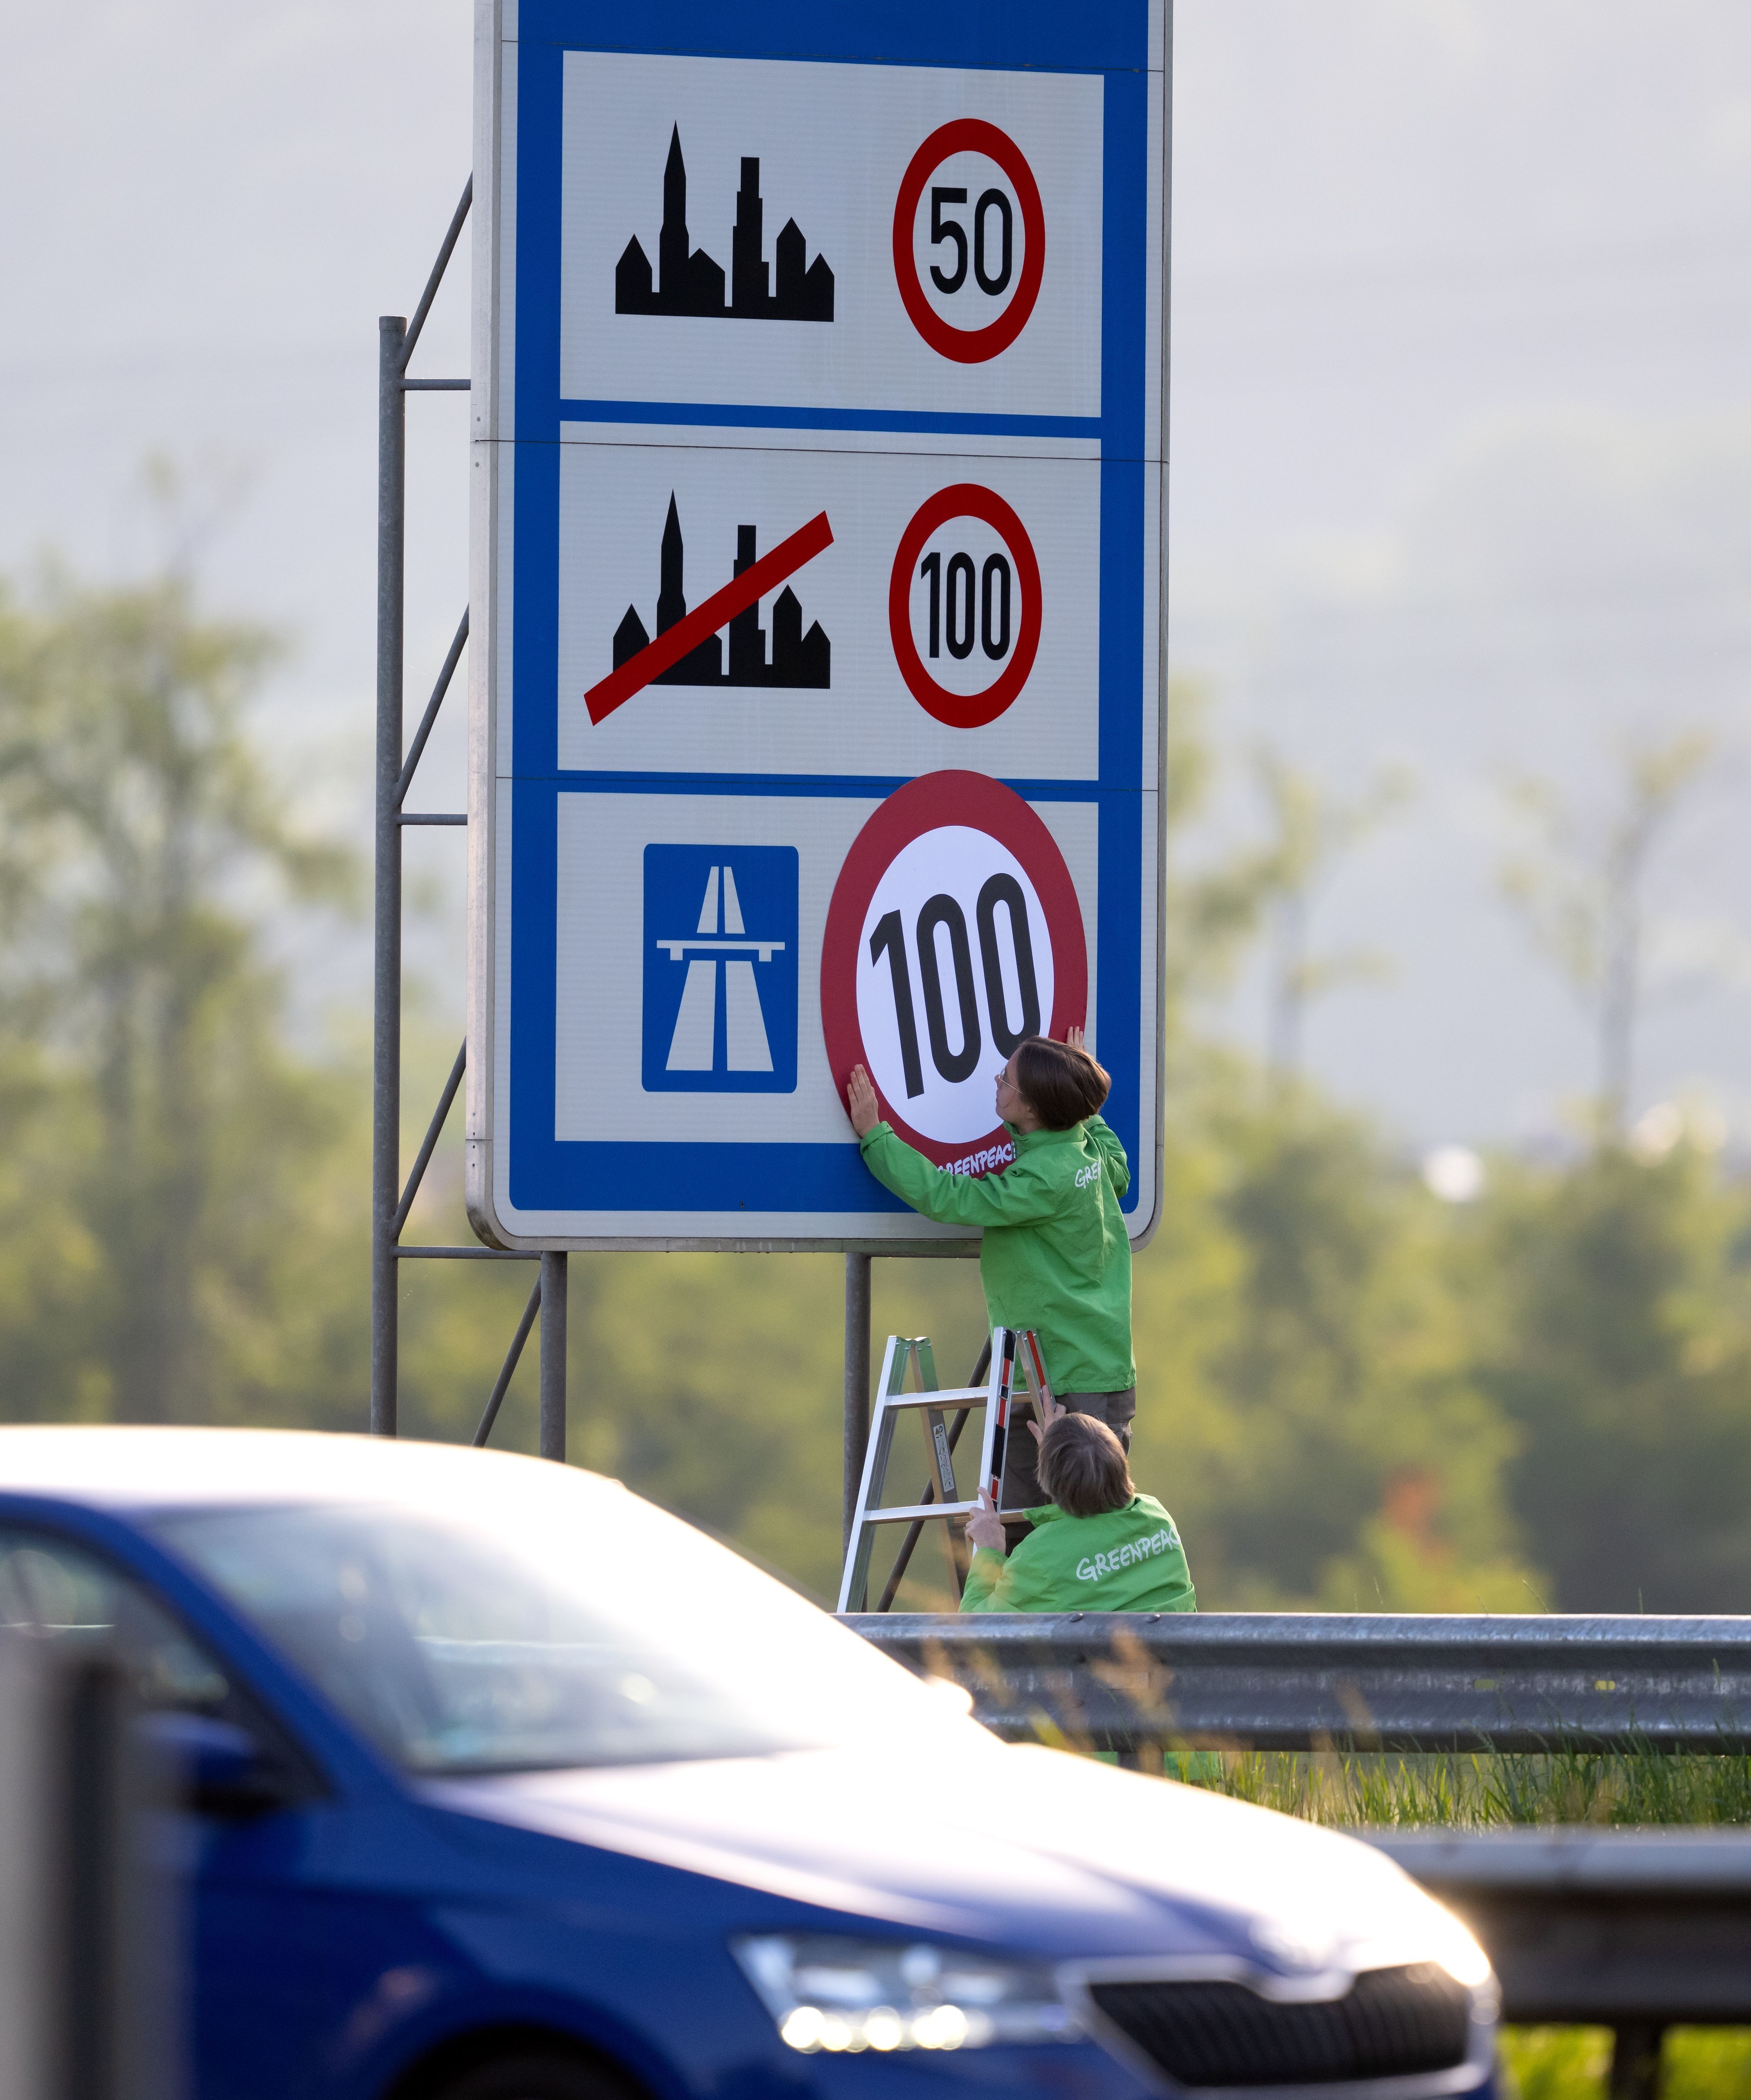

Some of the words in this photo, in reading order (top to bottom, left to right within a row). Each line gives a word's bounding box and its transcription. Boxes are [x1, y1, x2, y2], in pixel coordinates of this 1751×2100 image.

[930, 187, 1013, 296] 50
[921, 552, 1011, 660] 100
[869, 873, 1041, 1099] 100
